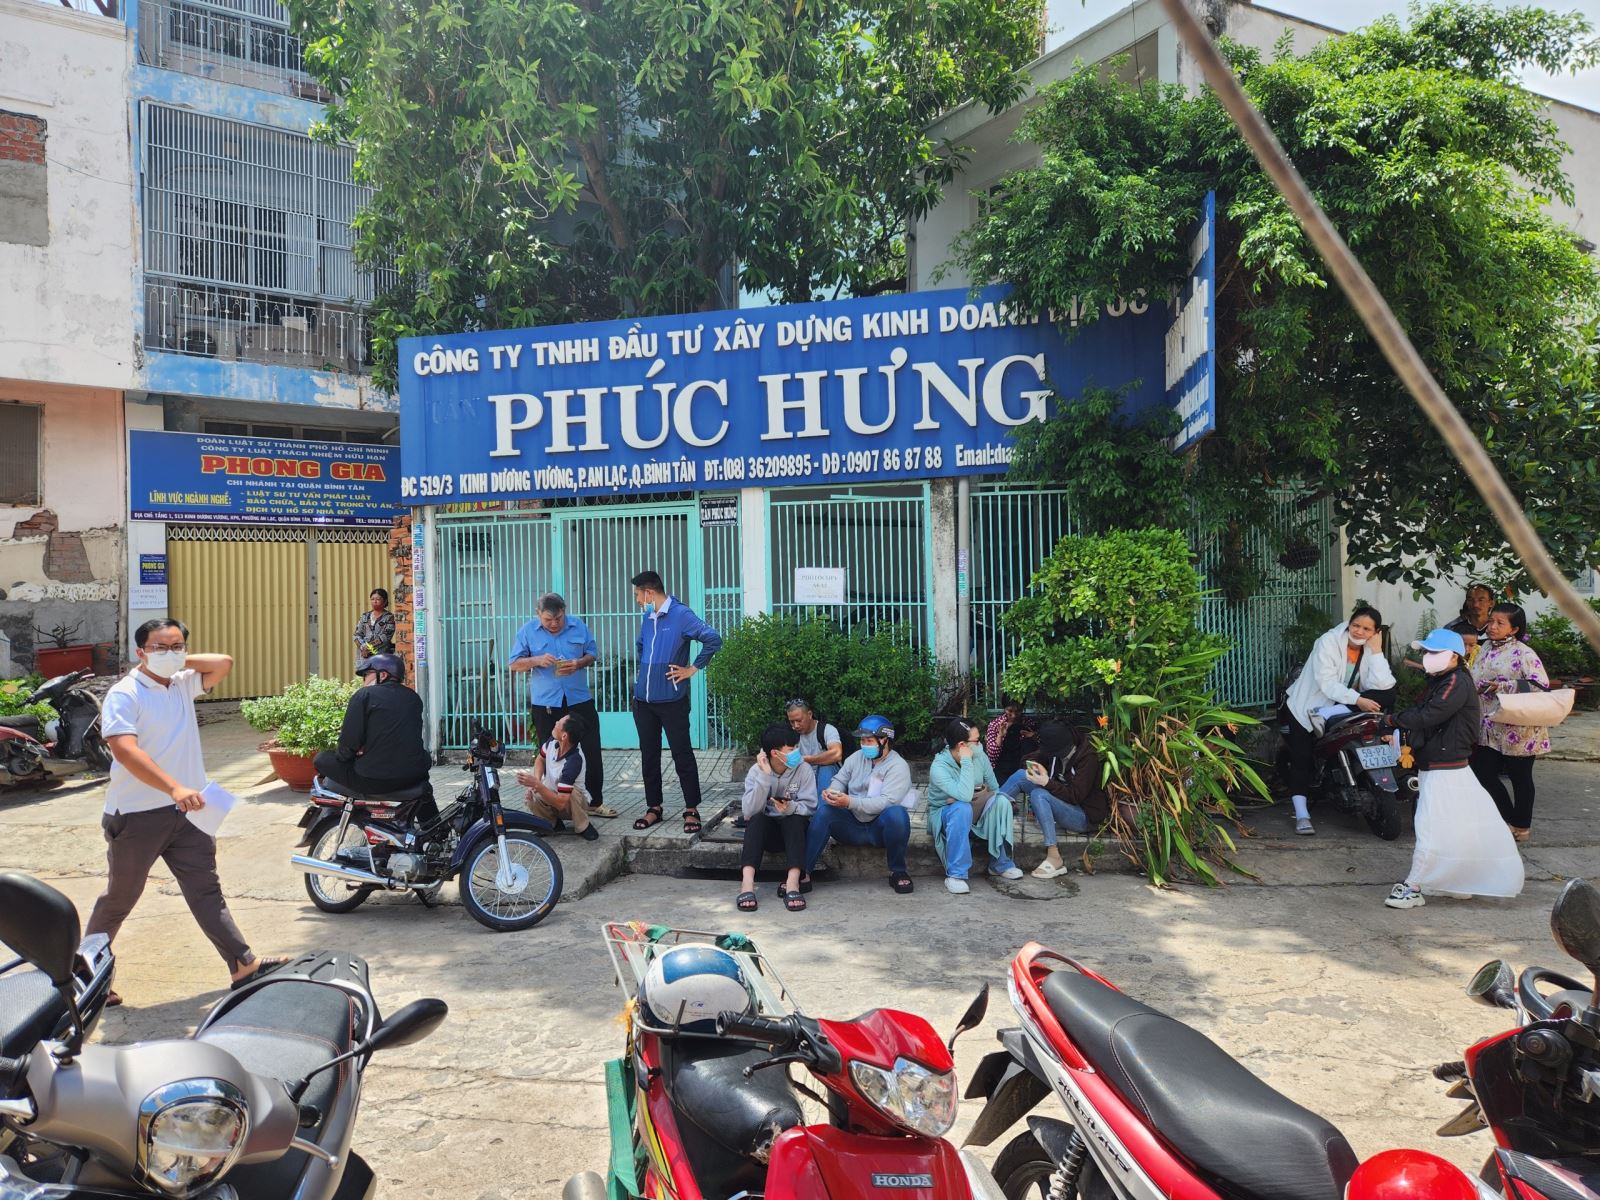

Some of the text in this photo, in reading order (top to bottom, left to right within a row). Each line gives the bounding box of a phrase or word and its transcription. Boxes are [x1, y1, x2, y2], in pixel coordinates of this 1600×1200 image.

[414, 344, 479, 376] CÔNG
[489, 344, 522, 370] TY
[532, 338, 600, 366] TNHH
[608, 322, 658, 360] ĐẦU
[667, 324, 704, 355] TƯ
[714, 318, 765, 352] XÂY
[777, 314, 852, 351] DỰNG
[863, 308, 929, 339] KINH
[488, 347, 1055, 457] PHÚC HƯNG
[197, 437, 226, 445] ĐOÀN
[229, 438, 253, 447] LUẬT
[274, 440, 306, 449] THÀNH
[200, 444, 229, 452] CÔNG
[248, 446, 272, 455] LUẬT
[276, 448, 308, 456] TRÁCH
[311, 451, 342, 459] NHIỆM
[345, 452, 364, 460] HỮU
[201, 454, 386, 482] PHONG GIA
[401, 476, 418, 497] ĐC
[420, 474, 453, 496] 519/3
[460, 473, 488, 494] KINH
[491, 468, 531, 493] DƯƠNG
[672, 455, 697, 483] TÂN
[748, 453, 812, 479] 36209895
[883, 448, 900, 471] 86
[904, 447, 921, 471] 87
[925, 446, 942, 469] 88
[955, 442, 1017, 467] Email:dia
[280, 481, 295, 489] TẠI
[297, 482, 321, 490] QUẬN
[324, 483, 345, 491] BÌNH
[347, 483, 365, 491] TÂN
[149, 489, 167, 503] LĨNH
[168, 491, 183, 505] VỰC
[185, 490, 209, 504] NGÀNH
[246, 489, 271, 498] LUẬT
[274, 490, 287, 498] SƯ
[323, 492, 348, 500] PHÁP
[349, 493, 371, 501] LUẬT
[286, 506, 299, 514] HỒ
[316, 507, 335, 515] NHÀ
[337, 507, 355, 516] ĐẤT
[335, 500, 364, 508] TRONG
[874, 1175, 933, 1186] HONDA
